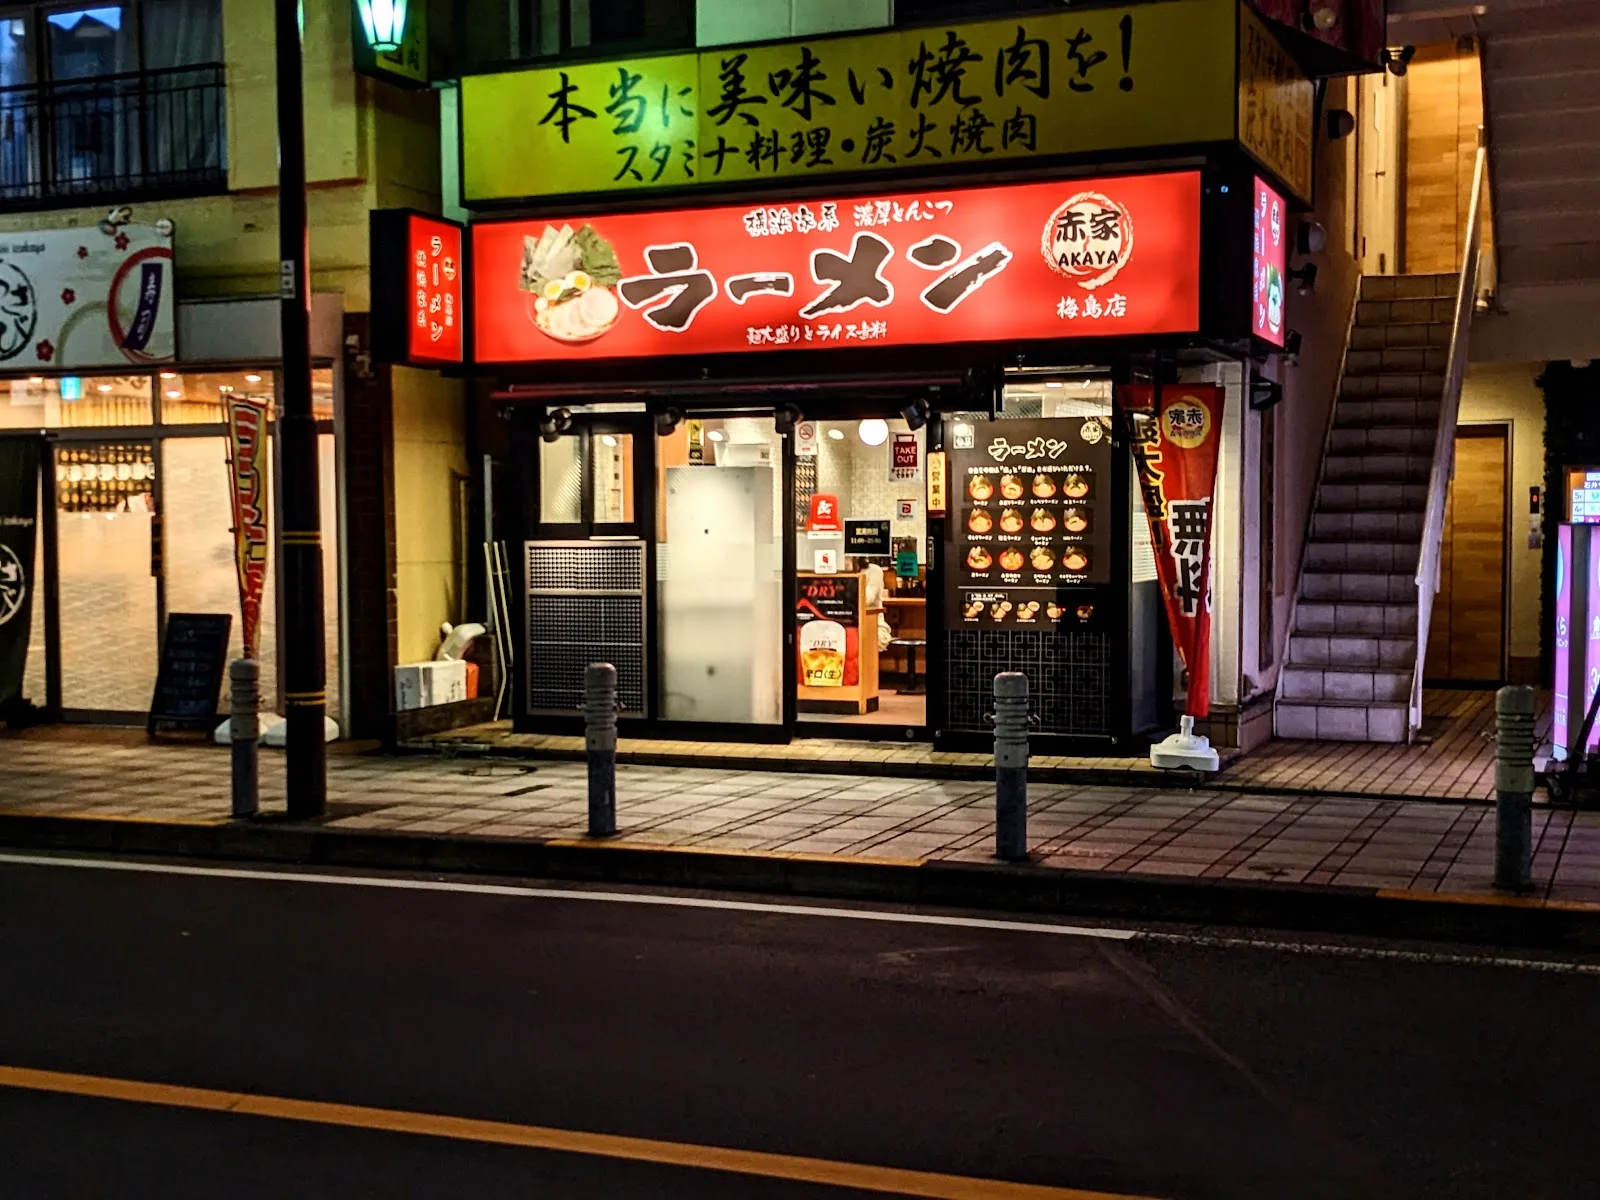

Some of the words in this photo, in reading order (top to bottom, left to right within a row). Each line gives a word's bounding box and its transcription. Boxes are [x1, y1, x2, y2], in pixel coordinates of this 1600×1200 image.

[612, 106, 1037, 182] スタミナ料理・炭火焼肉
[1057, 208, 1121, 242] 赤家
[1058, 250, 1119, 267] AKAYA
[429, 235, 443, 342] ラーメン
[616, 230, 1014, 333] ラーメン
[1056, 293, 1127, 319] 梅島店
[895, 446, 917, 455] TAKE
[897, 455, 914, 463] OUT
[988, 438, 1067, 462] ラーメン
